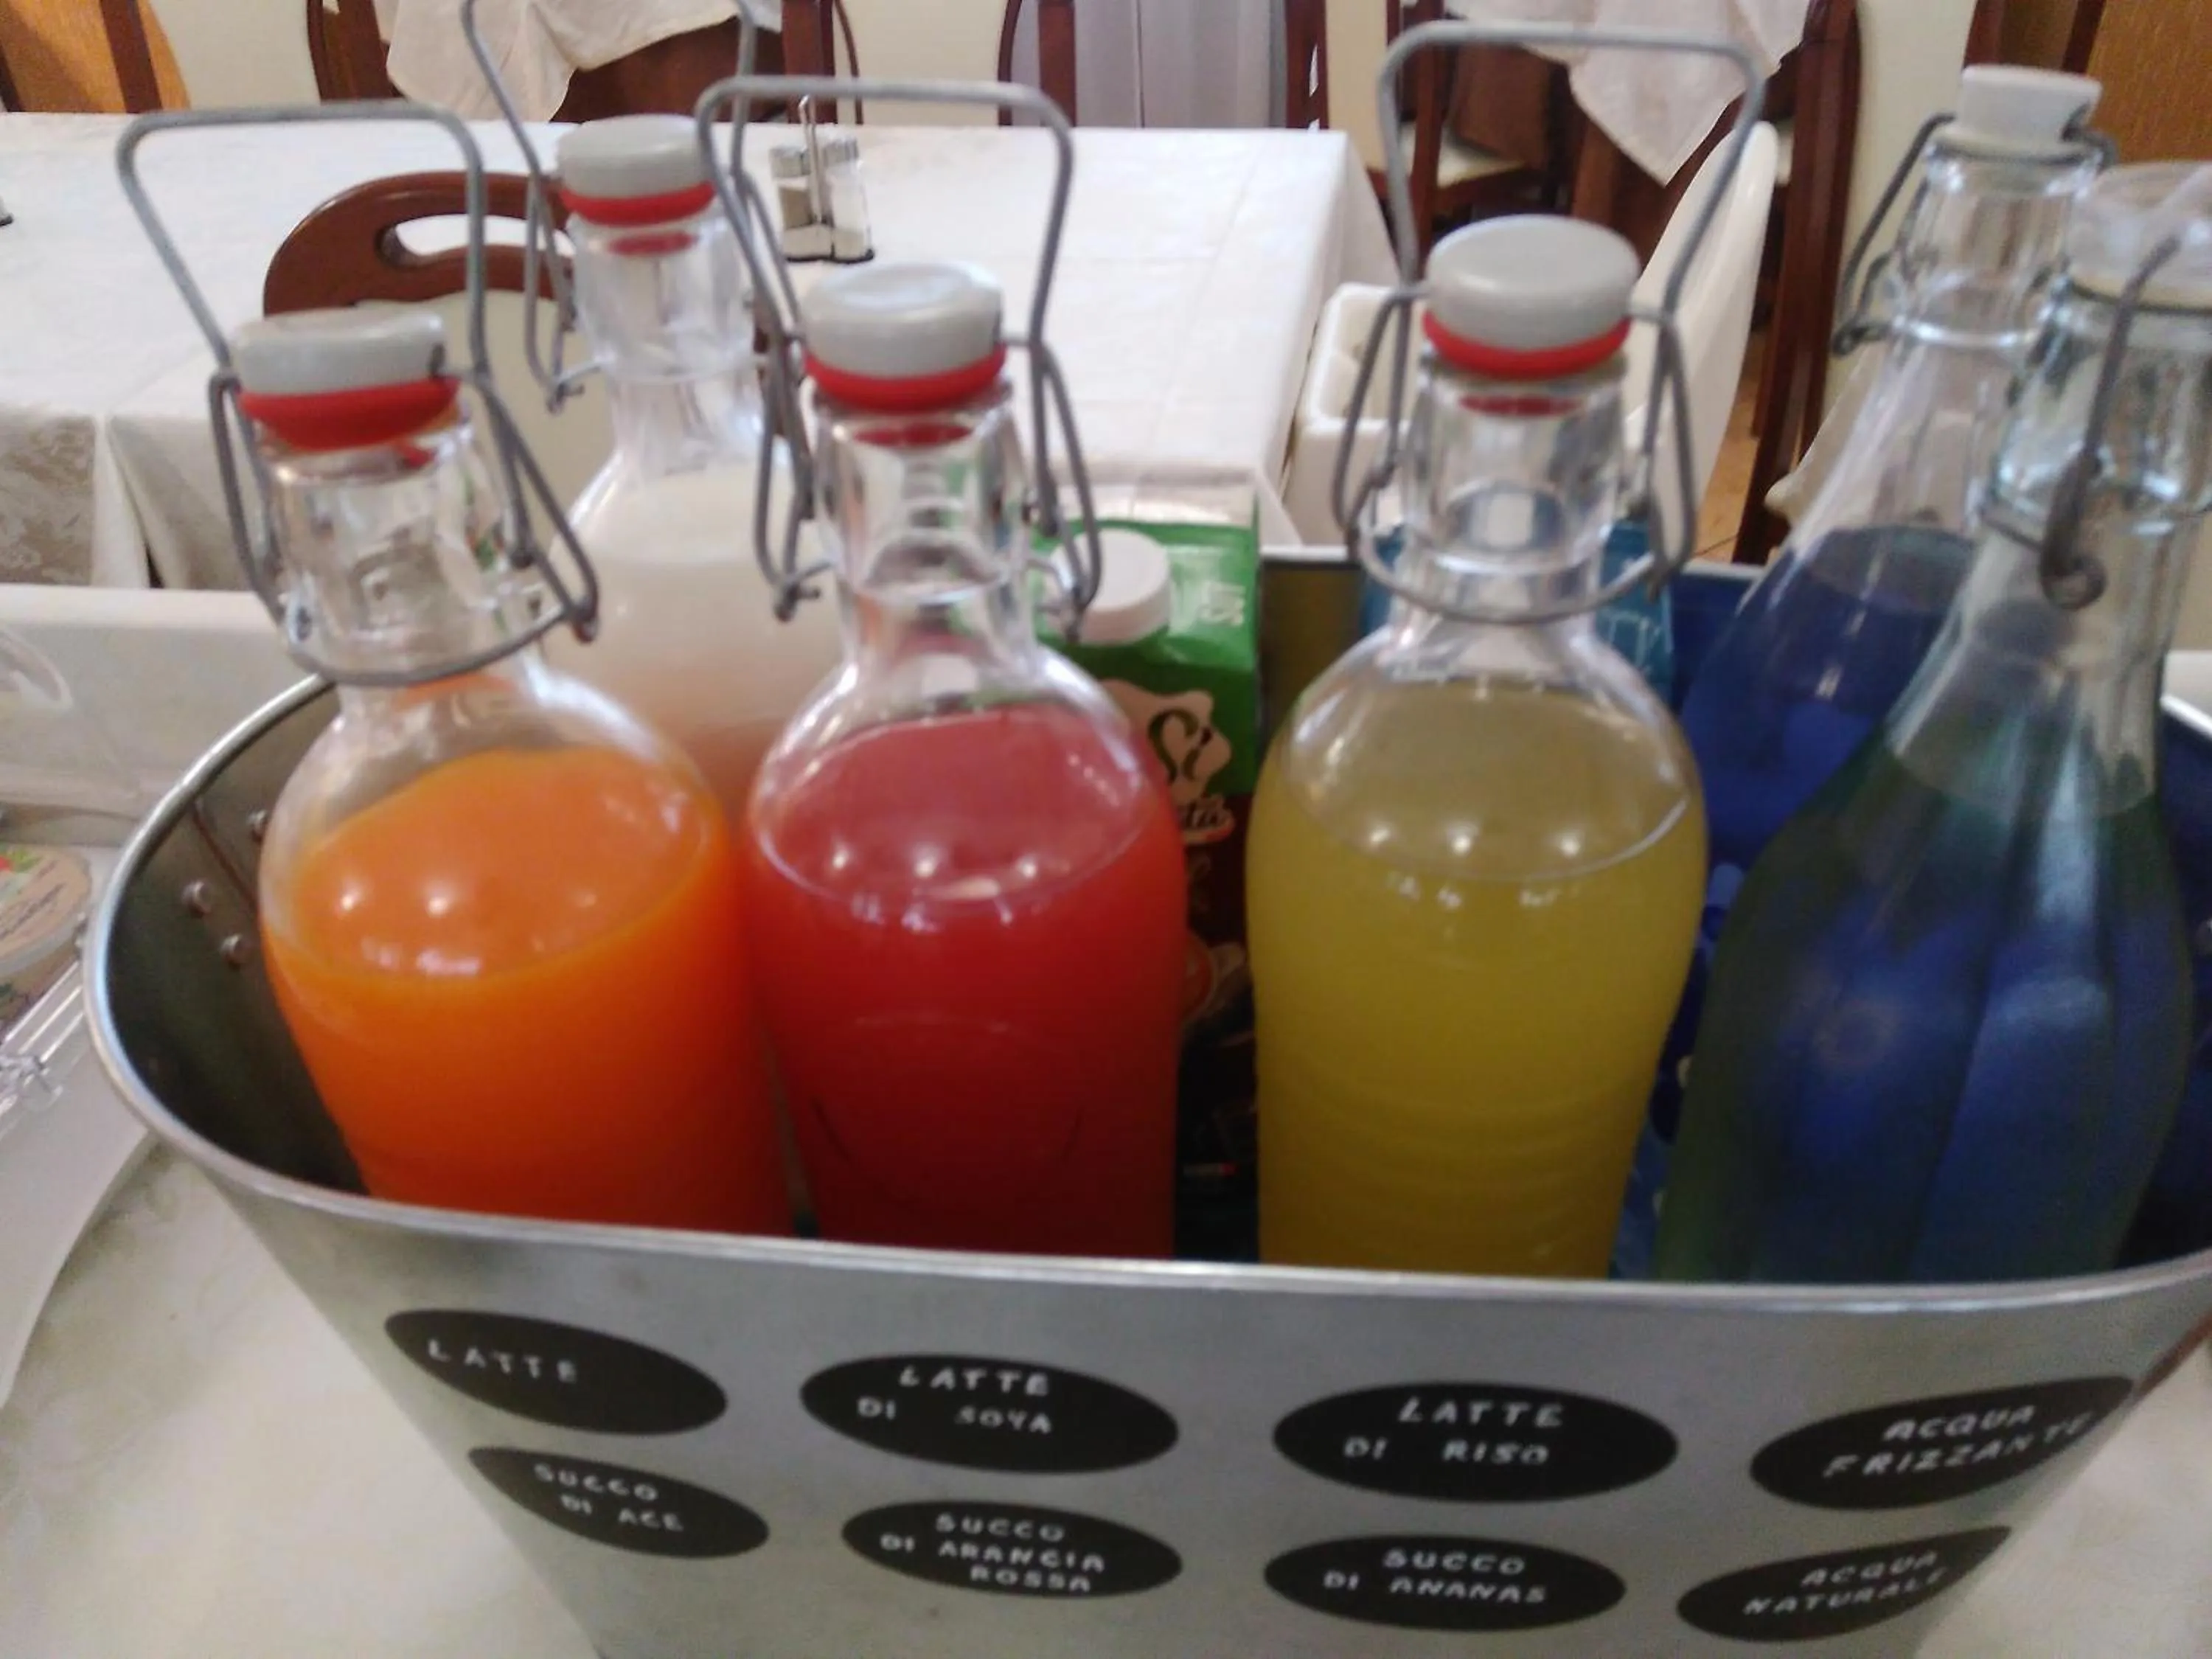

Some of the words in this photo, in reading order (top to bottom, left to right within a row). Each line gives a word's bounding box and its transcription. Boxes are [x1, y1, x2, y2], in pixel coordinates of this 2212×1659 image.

[428, 1338, 578, 1383] LATTE
[899, 1365, 1050, 1397] LATTE
[857, 1397, 897, 1419] DI
[955, 1405, 1052, 1433] SOYA
[1398, 1397, 1565, 1427] LATTE
[1882, 1405, 2036, 1441] ACQUA
[1343, 1436, 1388, 1460] DI
[1441, 1439, 1551, 1464] RISO
[533, 1462, 658, 1502] SUCCO
[560, 1494, 594, 1514] DI
[617, 1508, 685, 1532] ACE
[935, 1512, 1065, 1542] SUCCO
[880, 1533, 915, 1552] DI
[1382, 1548, 1526, 1575] SUCCO
[1801, 1551, 1938, 1588] ACQUA
[970, 1565, 1091, 1593] ROSSA
[1323, 1571, 1358, 1591] DI
[1389, 1576, 1547, 1604] ANANAS
